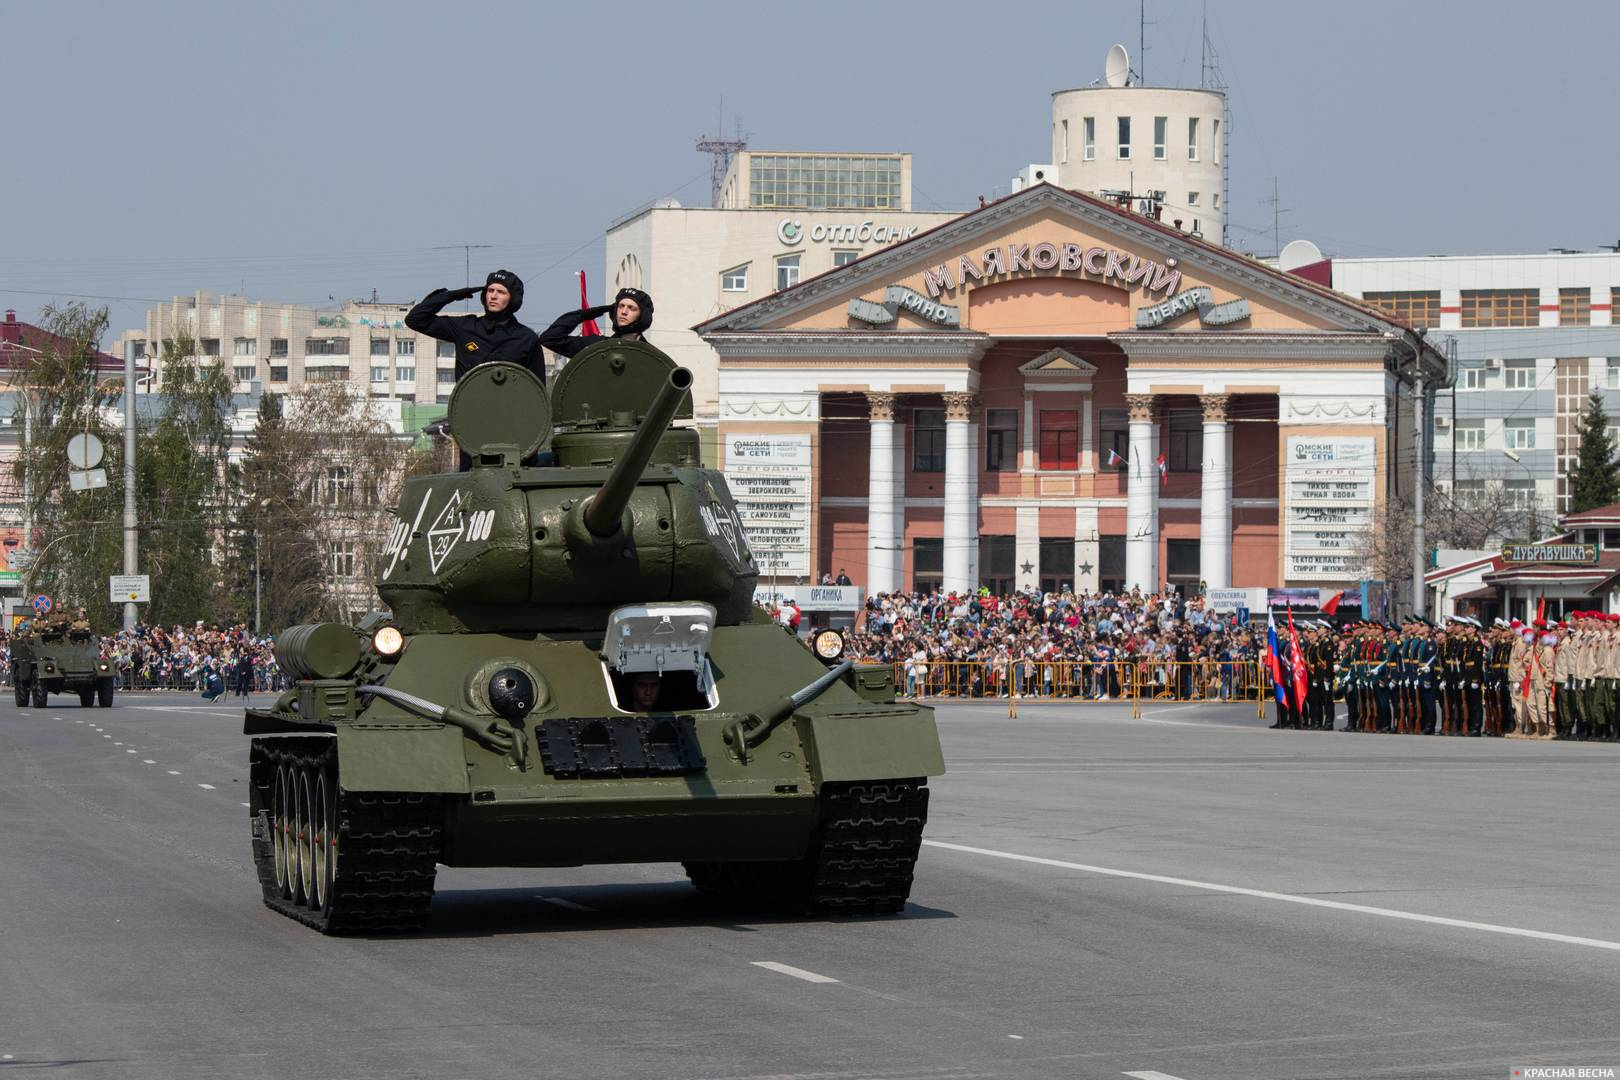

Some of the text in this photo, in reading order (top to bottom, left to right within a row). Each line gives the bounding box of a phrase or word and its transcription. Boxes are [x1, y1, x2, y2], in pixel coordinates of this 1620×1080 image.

[923, 242, 1182, 297] МАЯКОВСКИЙ
[900, 290, 948, 320] КИНО
[1148, 290, 1202, 321] ТЕАТР
[444, 506, 456, 525] А
[465, 509, 495, 542] 100
[434, 535, 450, 556] 29
[1513, 546, 1585, 561] ДУБРАВУШКА
[811, 588, 843, 601] ОРГАНИКА
